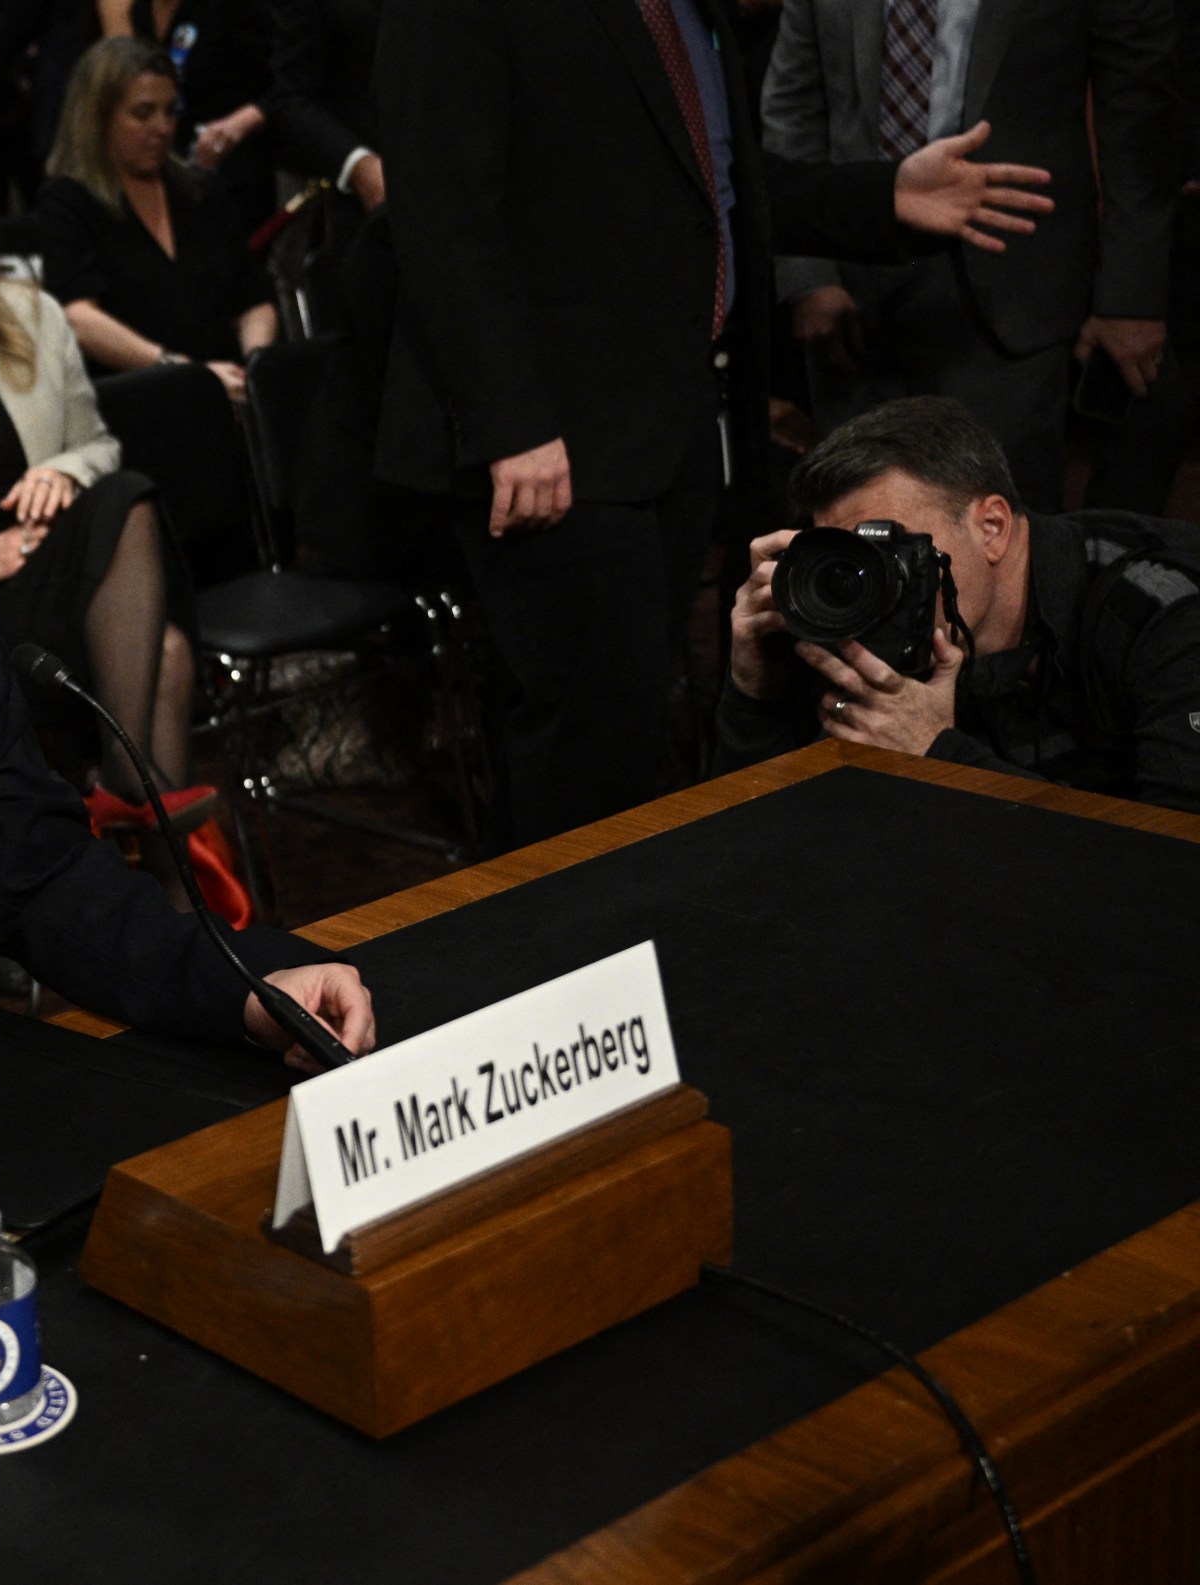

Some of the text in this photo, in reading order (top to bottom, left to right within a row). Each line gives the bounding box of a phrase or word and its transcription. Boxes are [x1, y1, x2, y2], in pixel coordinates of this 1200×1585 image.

[857, 528, 889, 536] Nikon
[335, 1015, 652, 1187] Mr. Mark Zuckerberg
